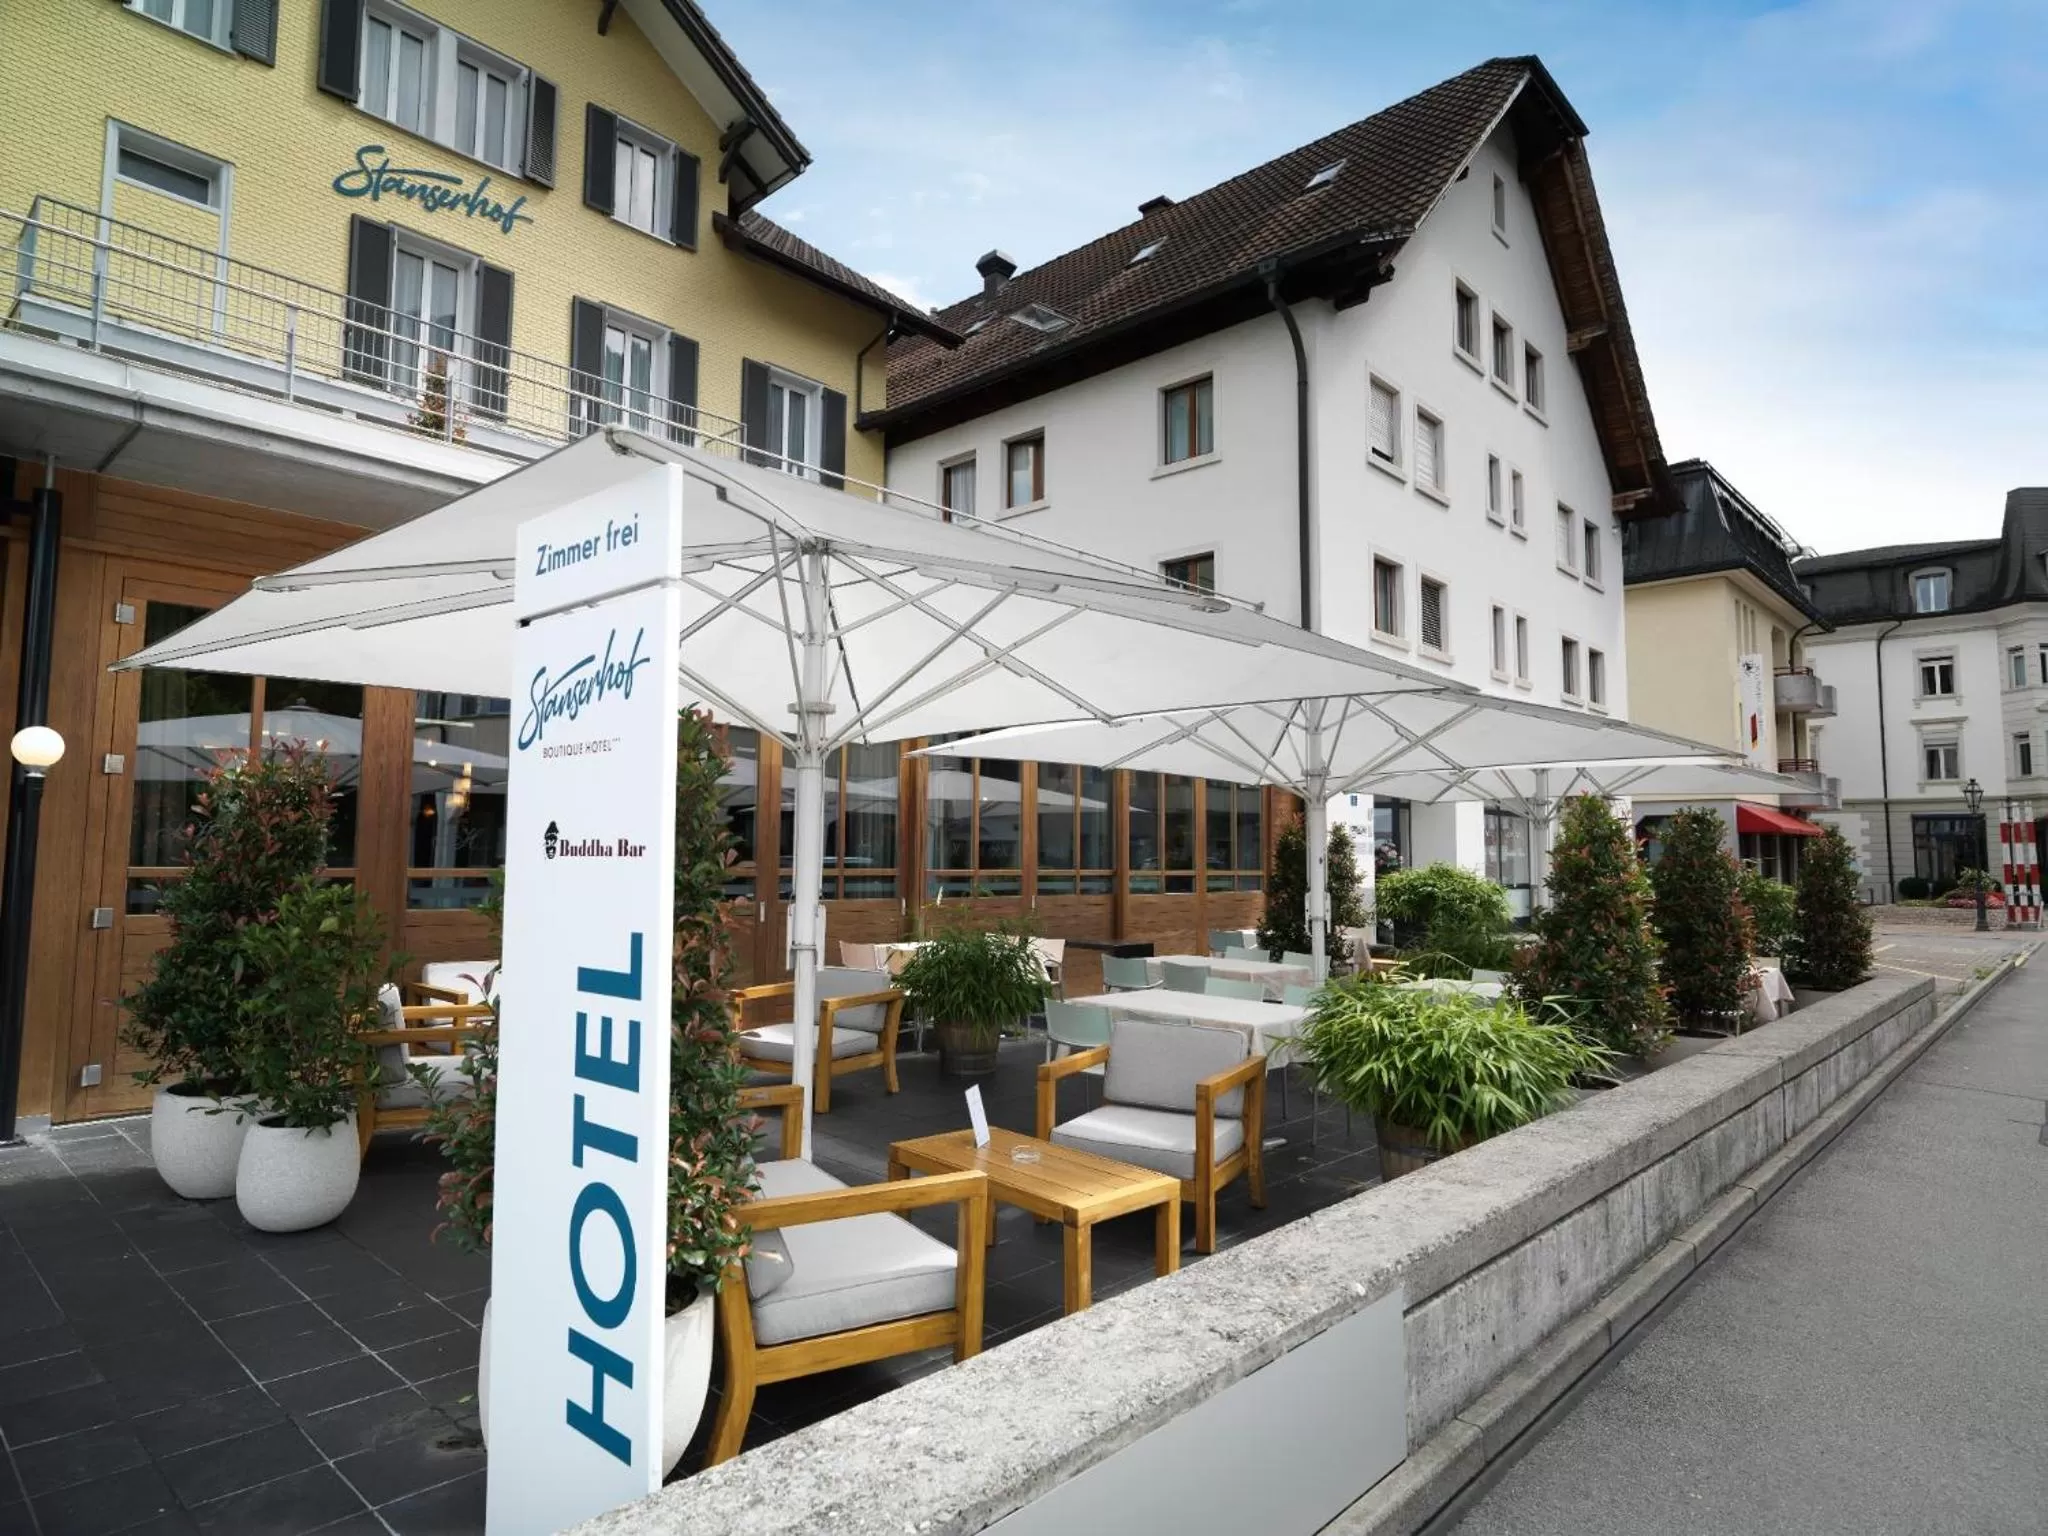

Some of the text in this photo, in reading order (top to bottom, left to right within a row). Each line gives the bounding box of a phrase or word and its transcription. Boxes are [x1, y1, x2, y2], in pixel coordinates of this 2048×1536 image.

[332, 144, 534, 235] Stanserhof
[535, 512, 639, 577] Zimmer frei
[517, 627, 651, 752] Stanserhof
[542, 739, 612, 759] BOUTIQUE HOTEL
[559, 838, 646, 857] Buddha Bar
[566, 931, 644, 1468] HOTEL
